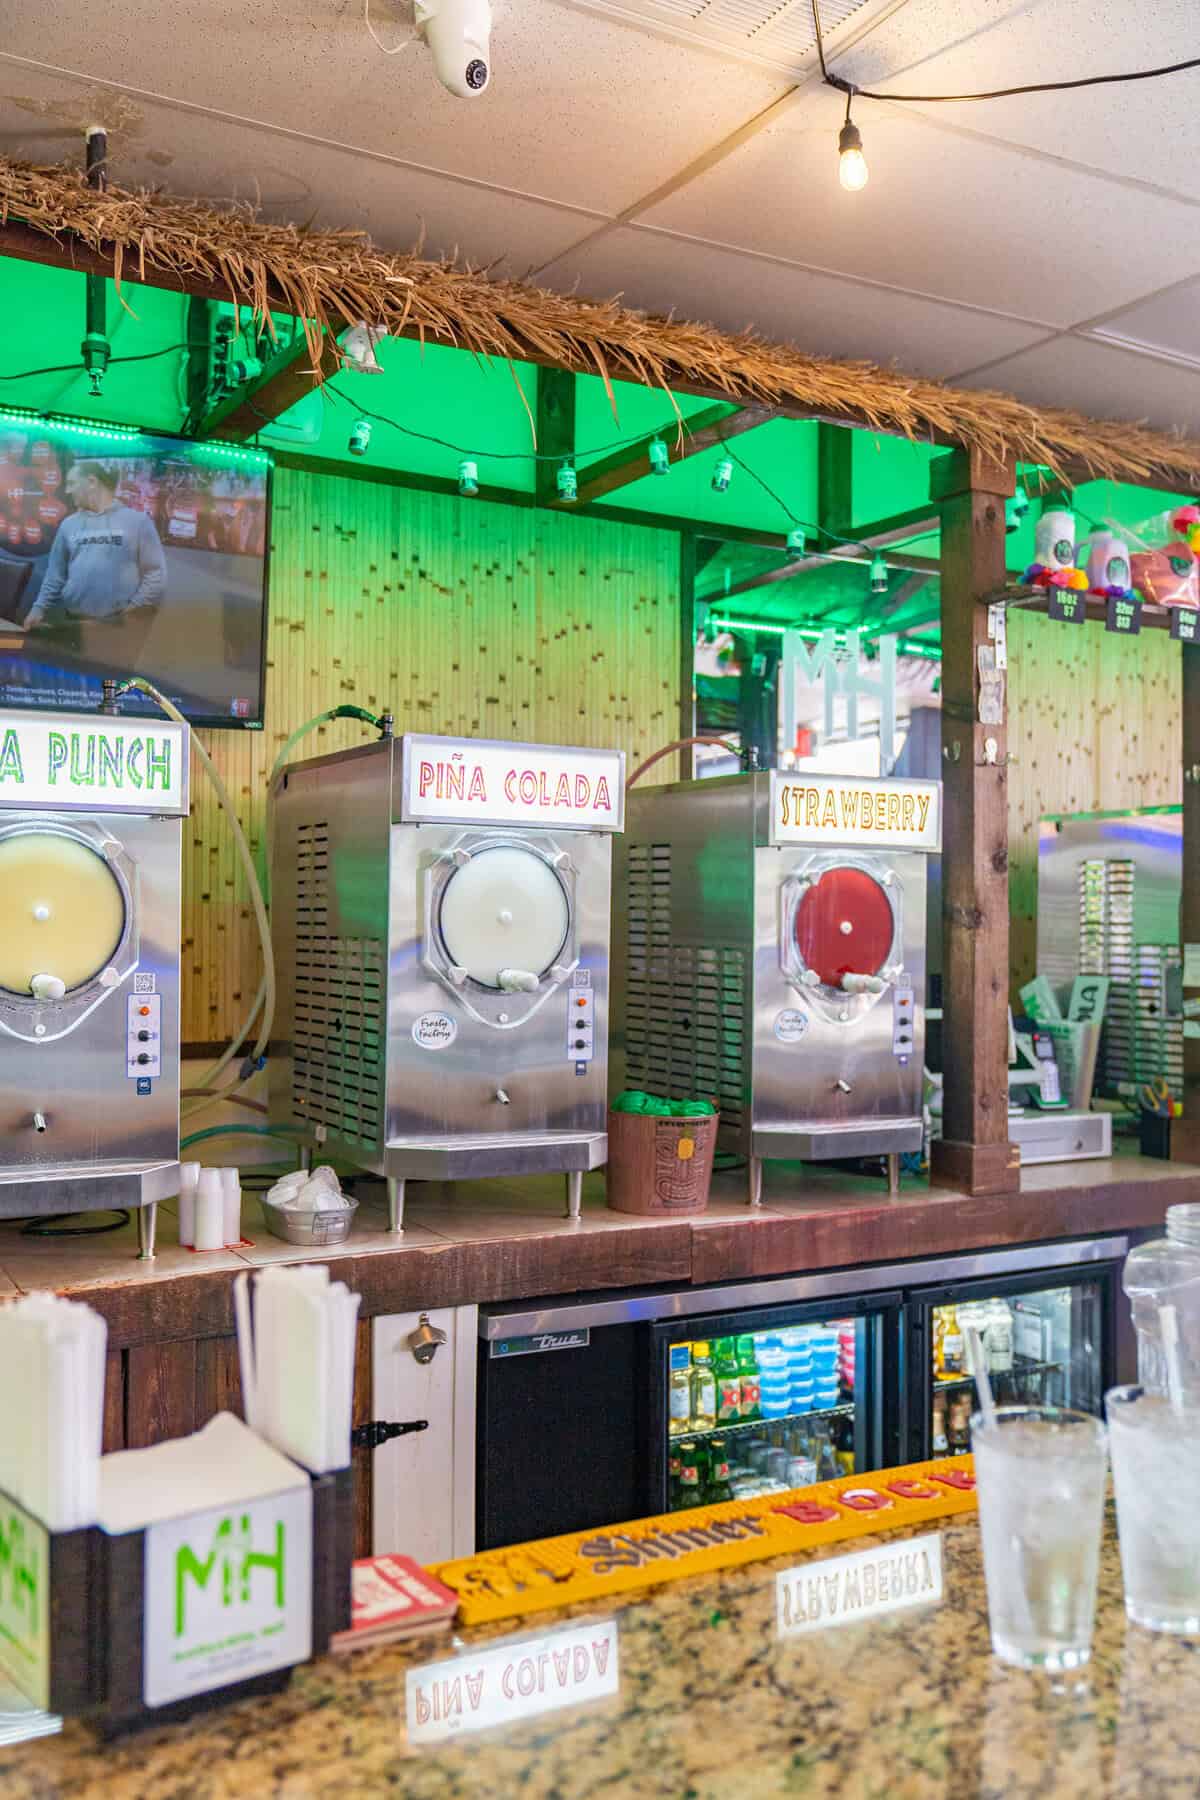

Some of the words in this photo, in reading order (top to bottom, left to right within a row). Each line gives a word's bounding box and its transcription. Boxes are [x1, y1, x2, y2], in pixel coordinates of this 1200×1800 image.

[48, 732, 171, 790] PUNCH
[419, 752, 487, 802] PIÑA
[504, 769, 611, 811] COLADA
[782, 786, 930, 832] STRAWBERRY
[580, 1515, 764, 1573] Shiner
